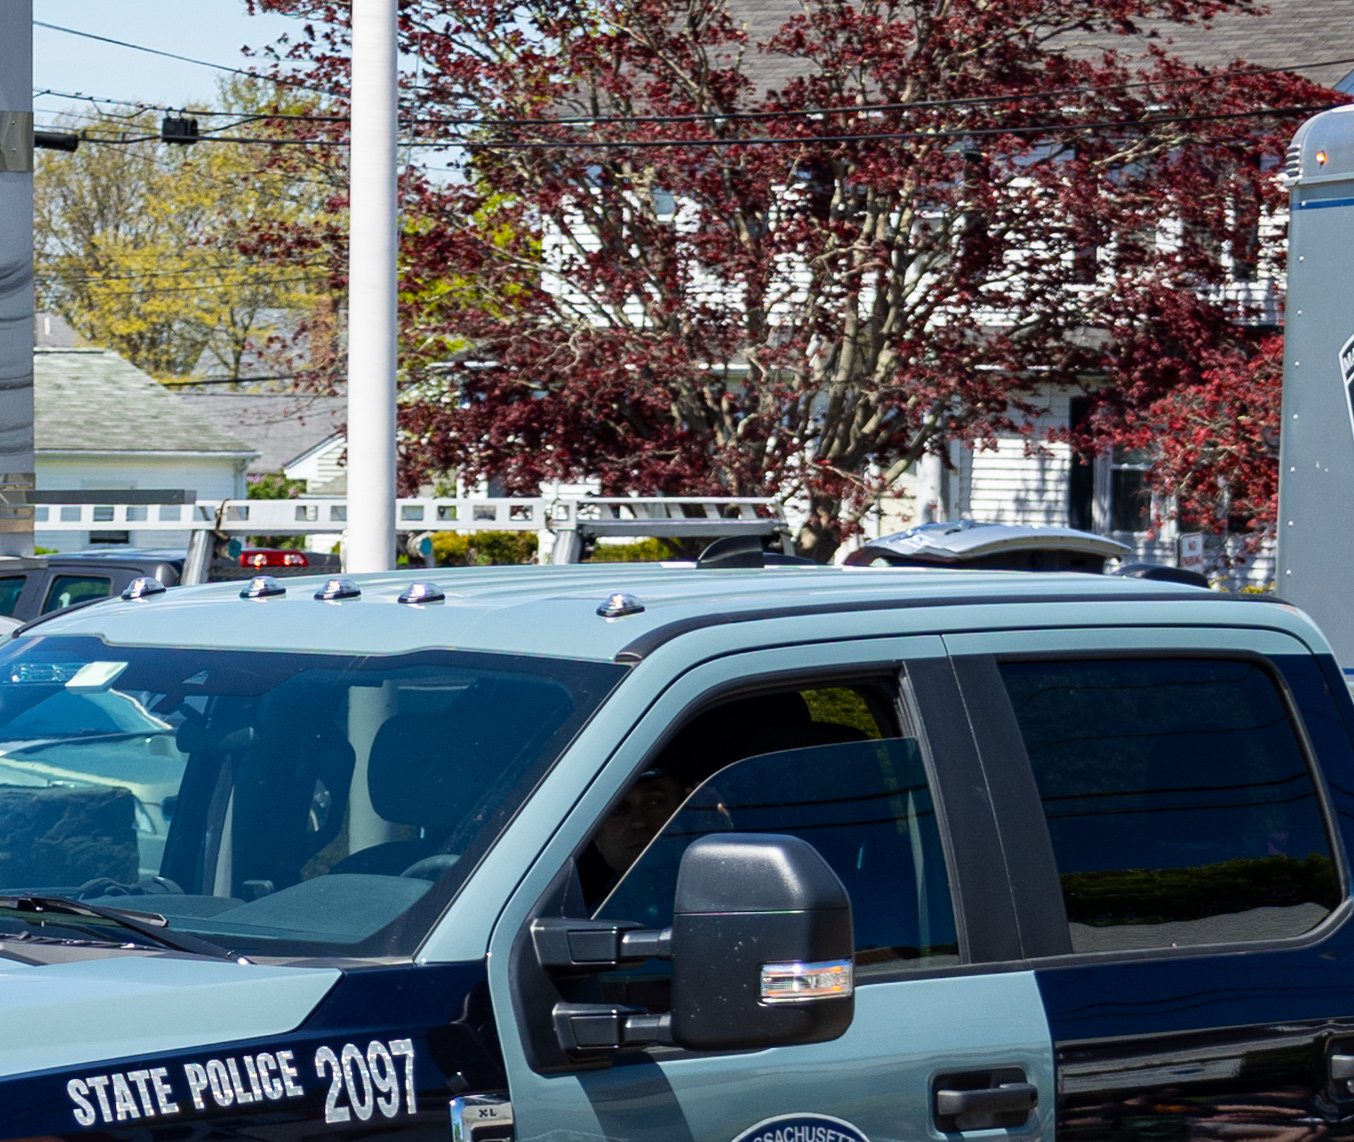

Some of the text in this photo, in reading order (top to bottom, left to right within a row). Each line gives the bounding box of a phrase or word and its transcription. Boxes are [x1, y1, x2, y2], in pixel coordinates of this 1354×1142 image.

[66, 1038, 418, 1127] STATE POLICE 2097
[478, 1108, 497, 1118] XL
